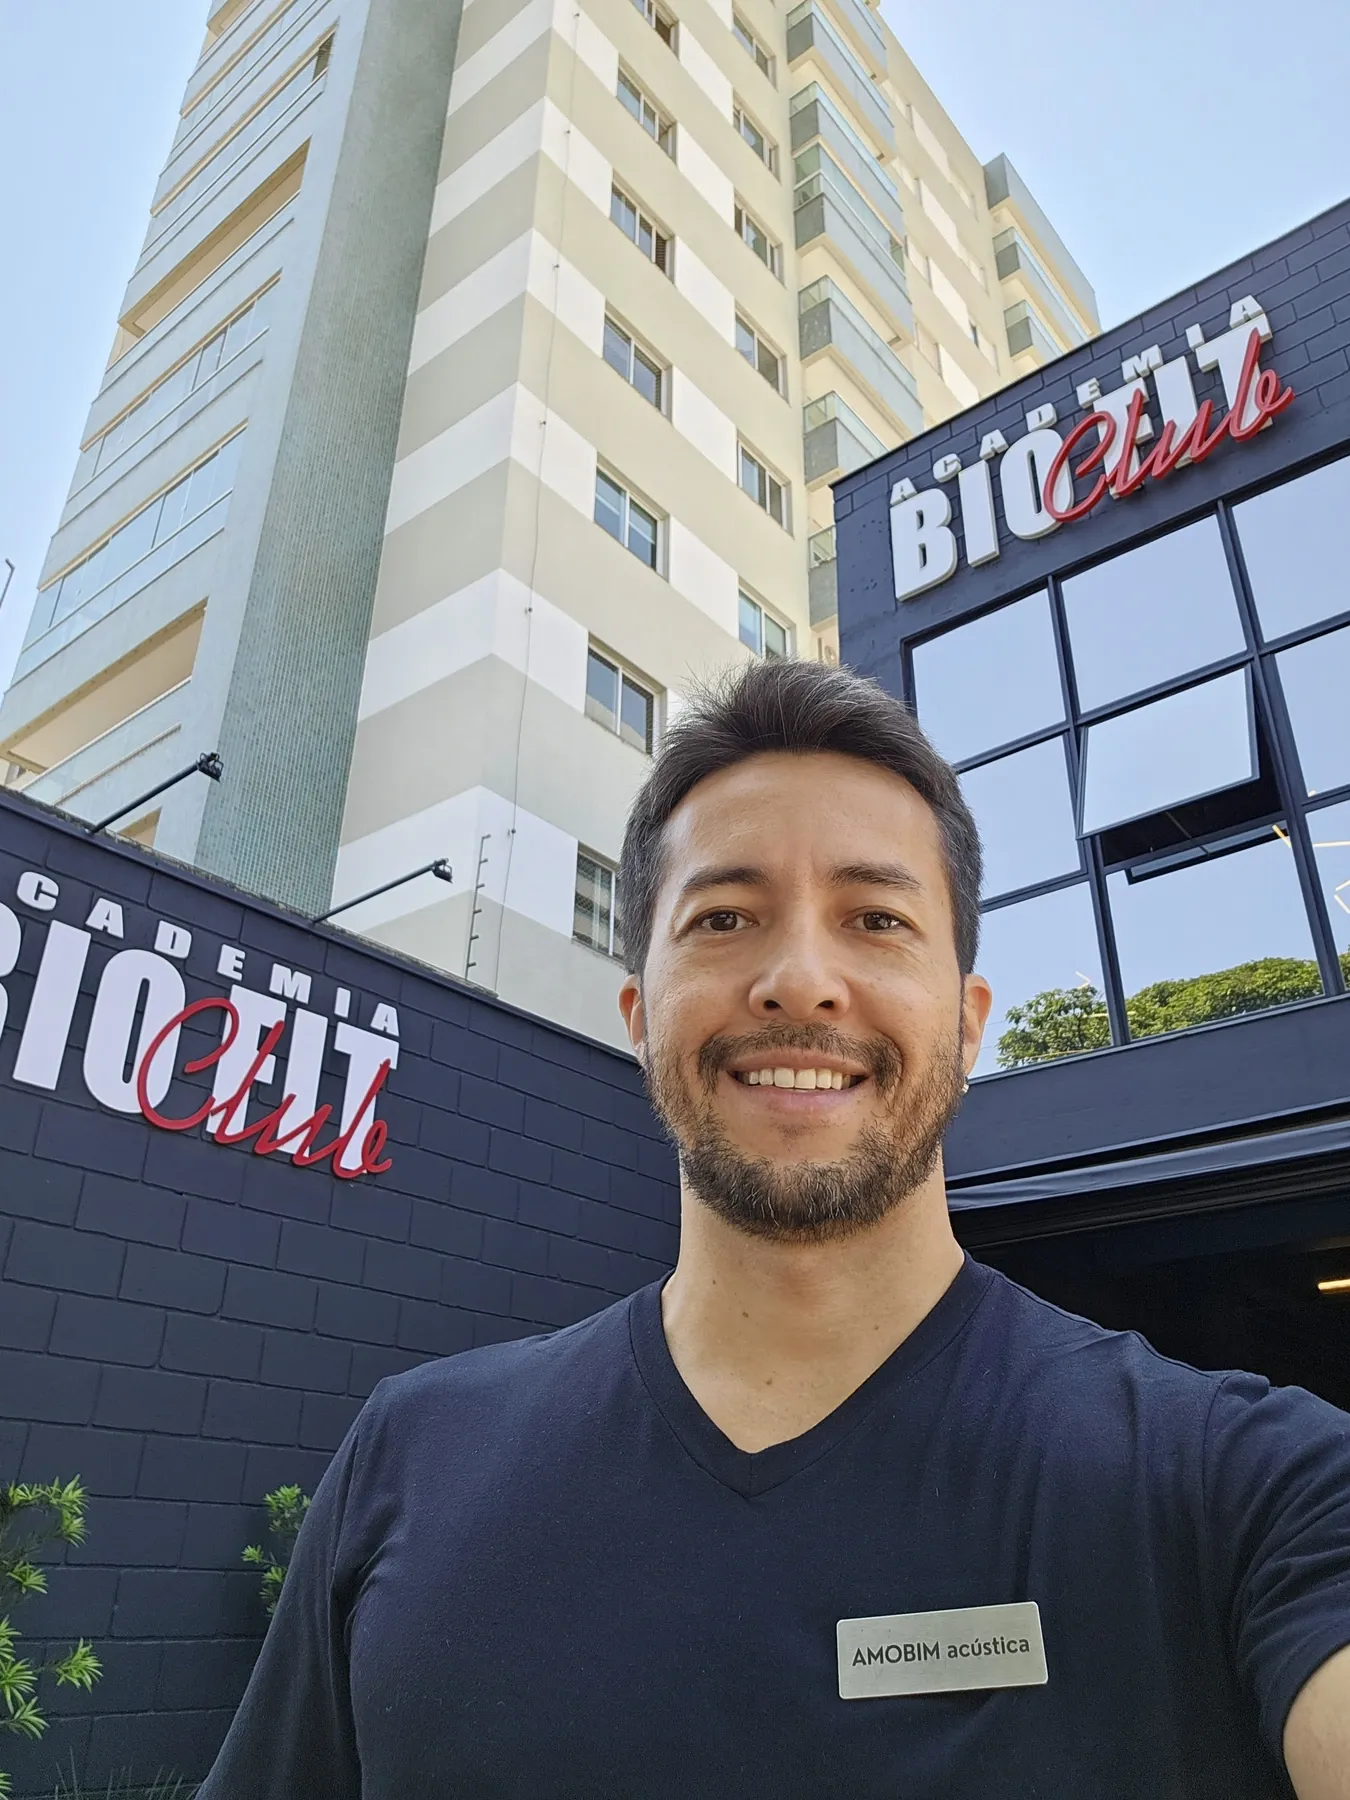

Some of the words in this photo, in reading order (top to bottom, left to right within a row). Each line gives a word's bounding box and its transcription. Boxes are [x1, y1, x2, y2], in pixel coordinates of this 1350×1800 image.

[889, 294, 1267, 505] ACADEMIA
[889, 312, 1273, 601] BIOFIT
[1043, 327, 1295, 522] Club
[137, 997, 393, 1179] Club
[852, 1641, 940, 1667] AMOBIM
[947, 1636, 1030, 1659] acústica
